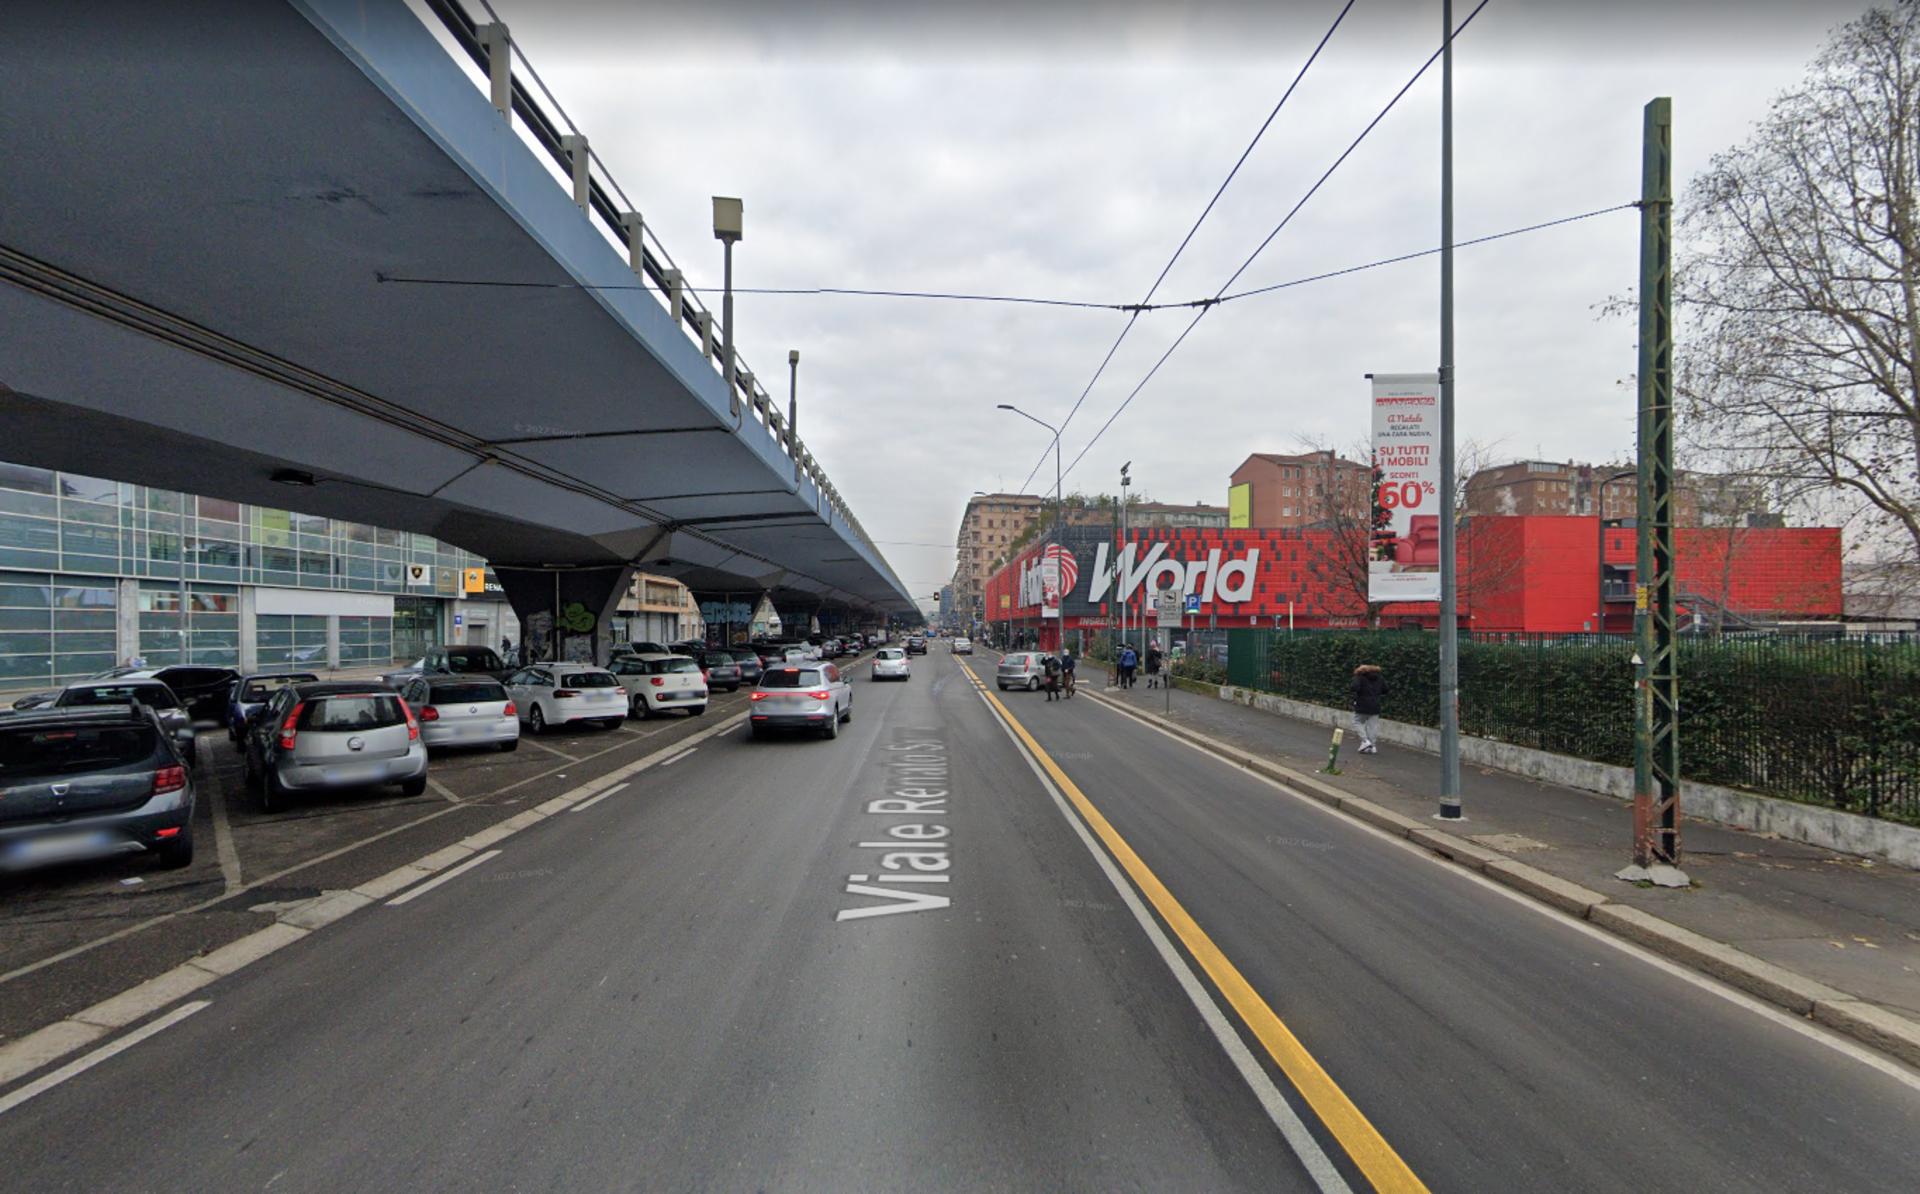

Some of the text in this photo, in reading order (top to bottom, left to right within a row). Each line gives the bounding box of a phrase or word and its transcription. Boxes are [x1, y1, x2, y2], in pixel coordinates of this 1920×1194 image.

[1379, 446, 1429, 456] SU TUTTI
[1387, 457, 1428, 466] MOBILI
[1378, 481, 1436, 509] 60%
[1088, 542, 1260, 603] World
[485, 583, 504, 592] RENA
[1189, 597, 1197, 607] P
